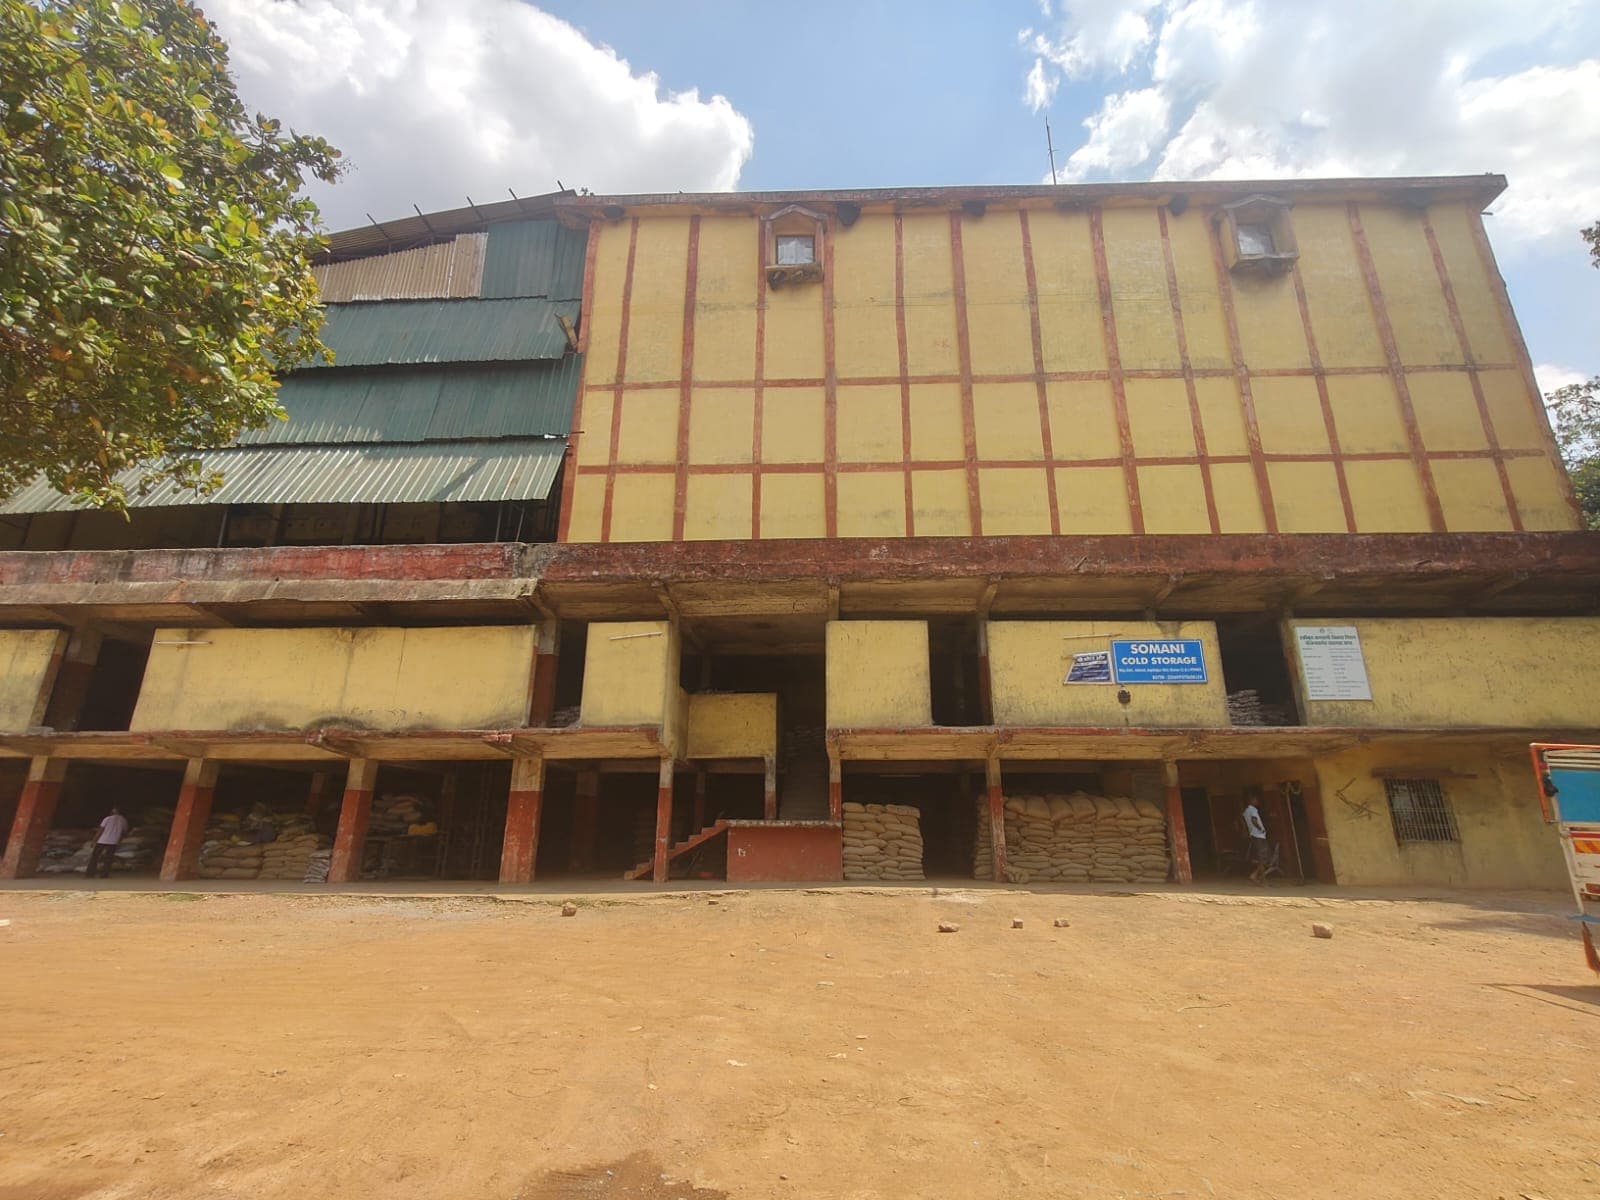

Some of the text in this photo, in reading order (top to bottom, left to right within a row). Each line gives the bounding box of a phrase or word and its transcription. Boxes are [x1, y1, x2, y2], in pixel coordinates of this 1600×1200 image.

[1130, 643, 1185, 654] SOMANI
[1121, 656, 1197, 665] COLD STORAGE
